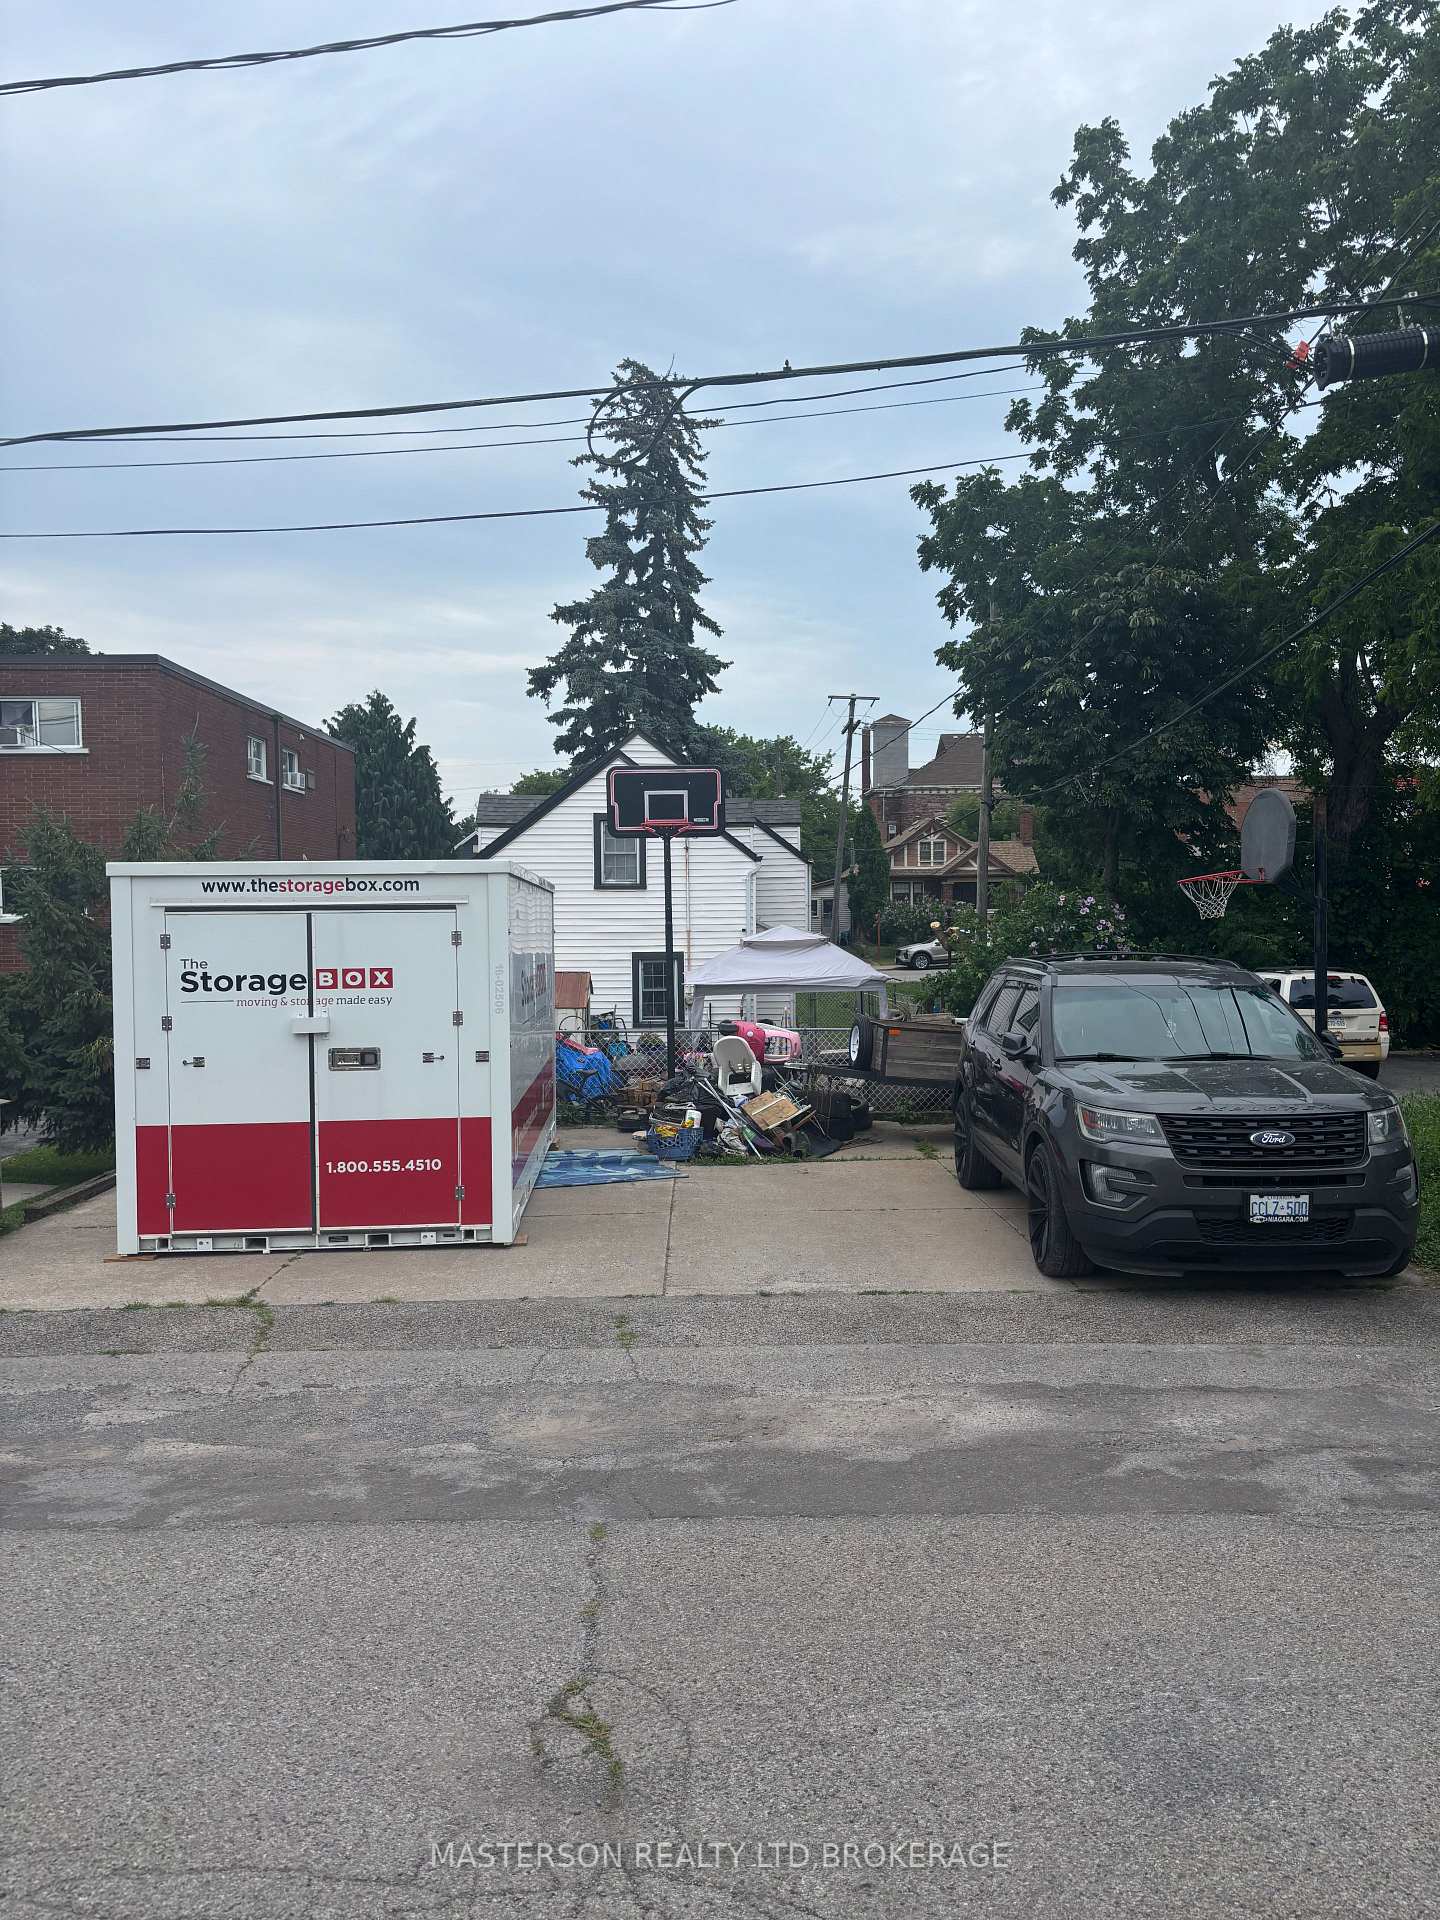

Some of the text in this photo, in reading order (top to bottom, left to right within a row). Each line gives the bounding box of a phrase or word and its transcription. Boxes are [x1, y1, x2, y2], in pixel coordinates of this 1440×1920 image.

[201, 877, 420, 894] www.thestoragebox.com
[180, 958, 209, 970] The
[180, 969, 390, 996] Storage BOX
[236, 996, 278, 1009] moving
[280, 996, 288, 1006] &
[336, 995, 365, 1006] made
[368, 995, 393, 1006] easy
[1261, 1133, 1286, 1144] Ford
[326, 1159, 442, 1173] 1.800.555.4510
[1286, 1201, 1308, 1216] 500
